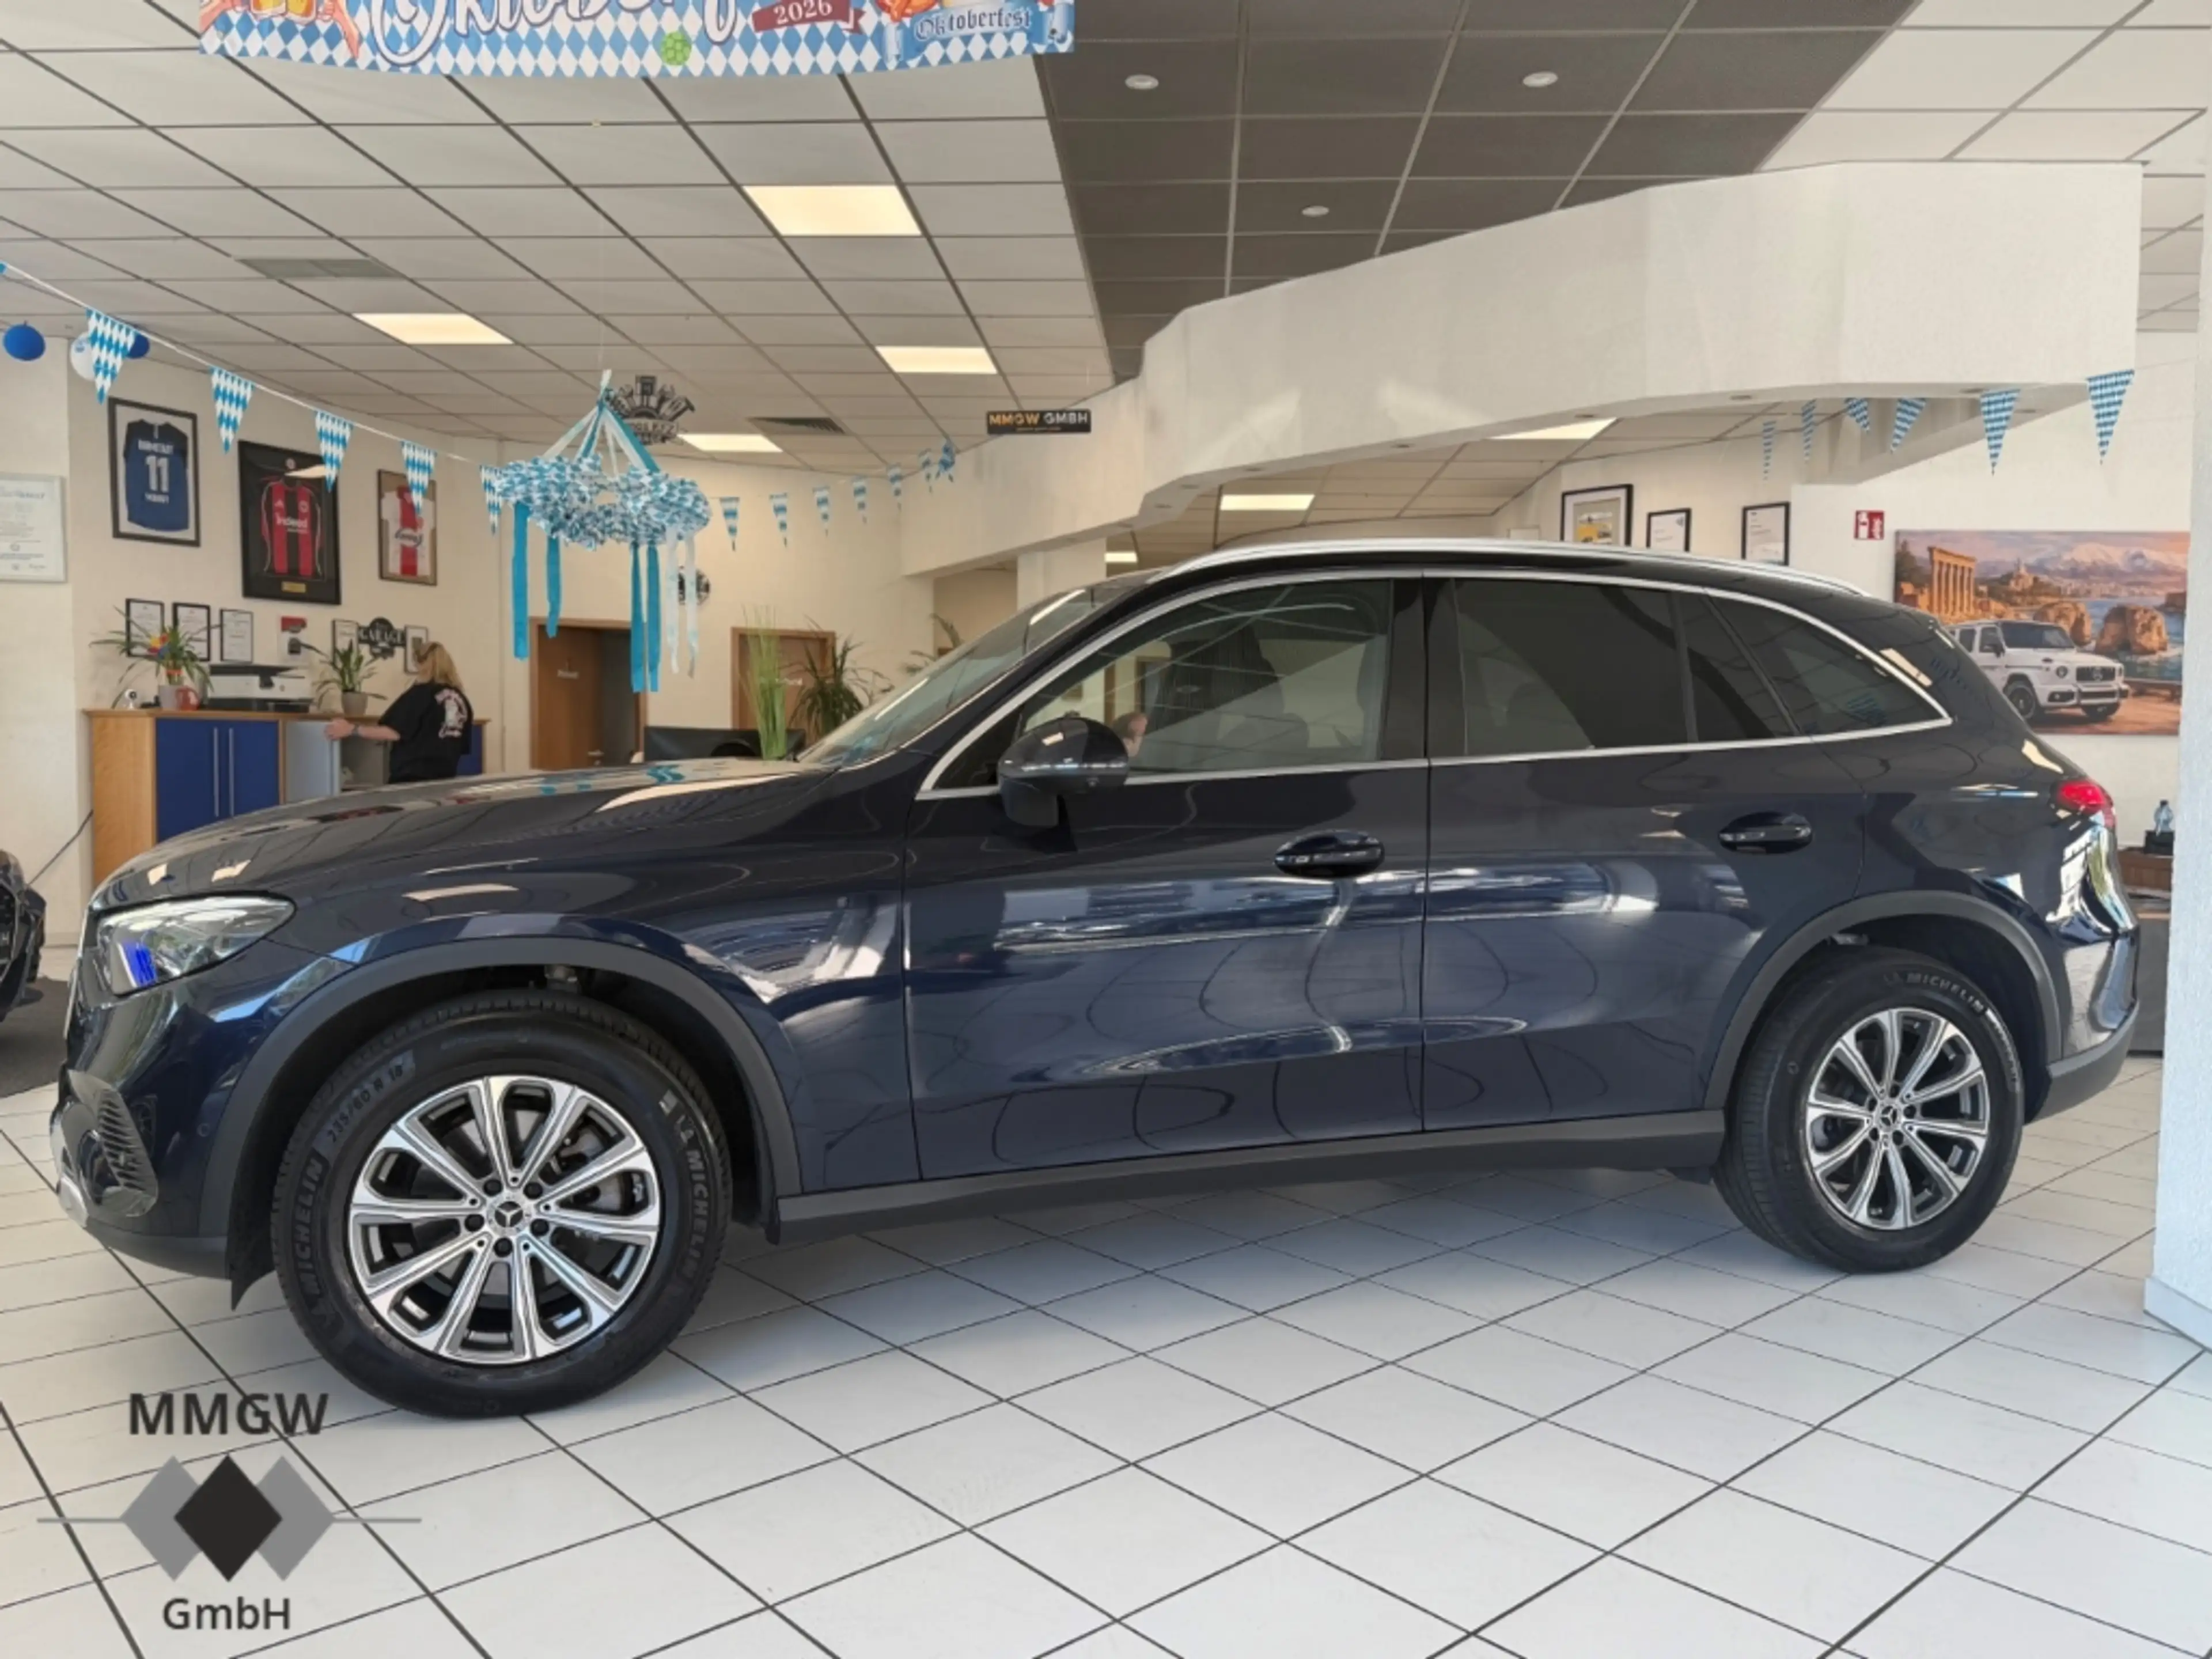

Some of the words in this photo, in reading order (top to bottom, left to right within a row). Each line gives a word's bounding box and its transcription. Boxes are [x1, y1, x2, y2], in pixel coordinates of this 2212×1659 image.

[774, 0, 832, 25] 2026
[989, 412, 1040, 426] MMGW
[1044, 412, 1088, 425] GMBH
[146, 455, 169, 493] 11
[1907, 972, 1984, 1013] MICHELIN
[294, 1154, 324, 1296] MICHELIN
[682, 1150, 709, 1278] MICHELIN
